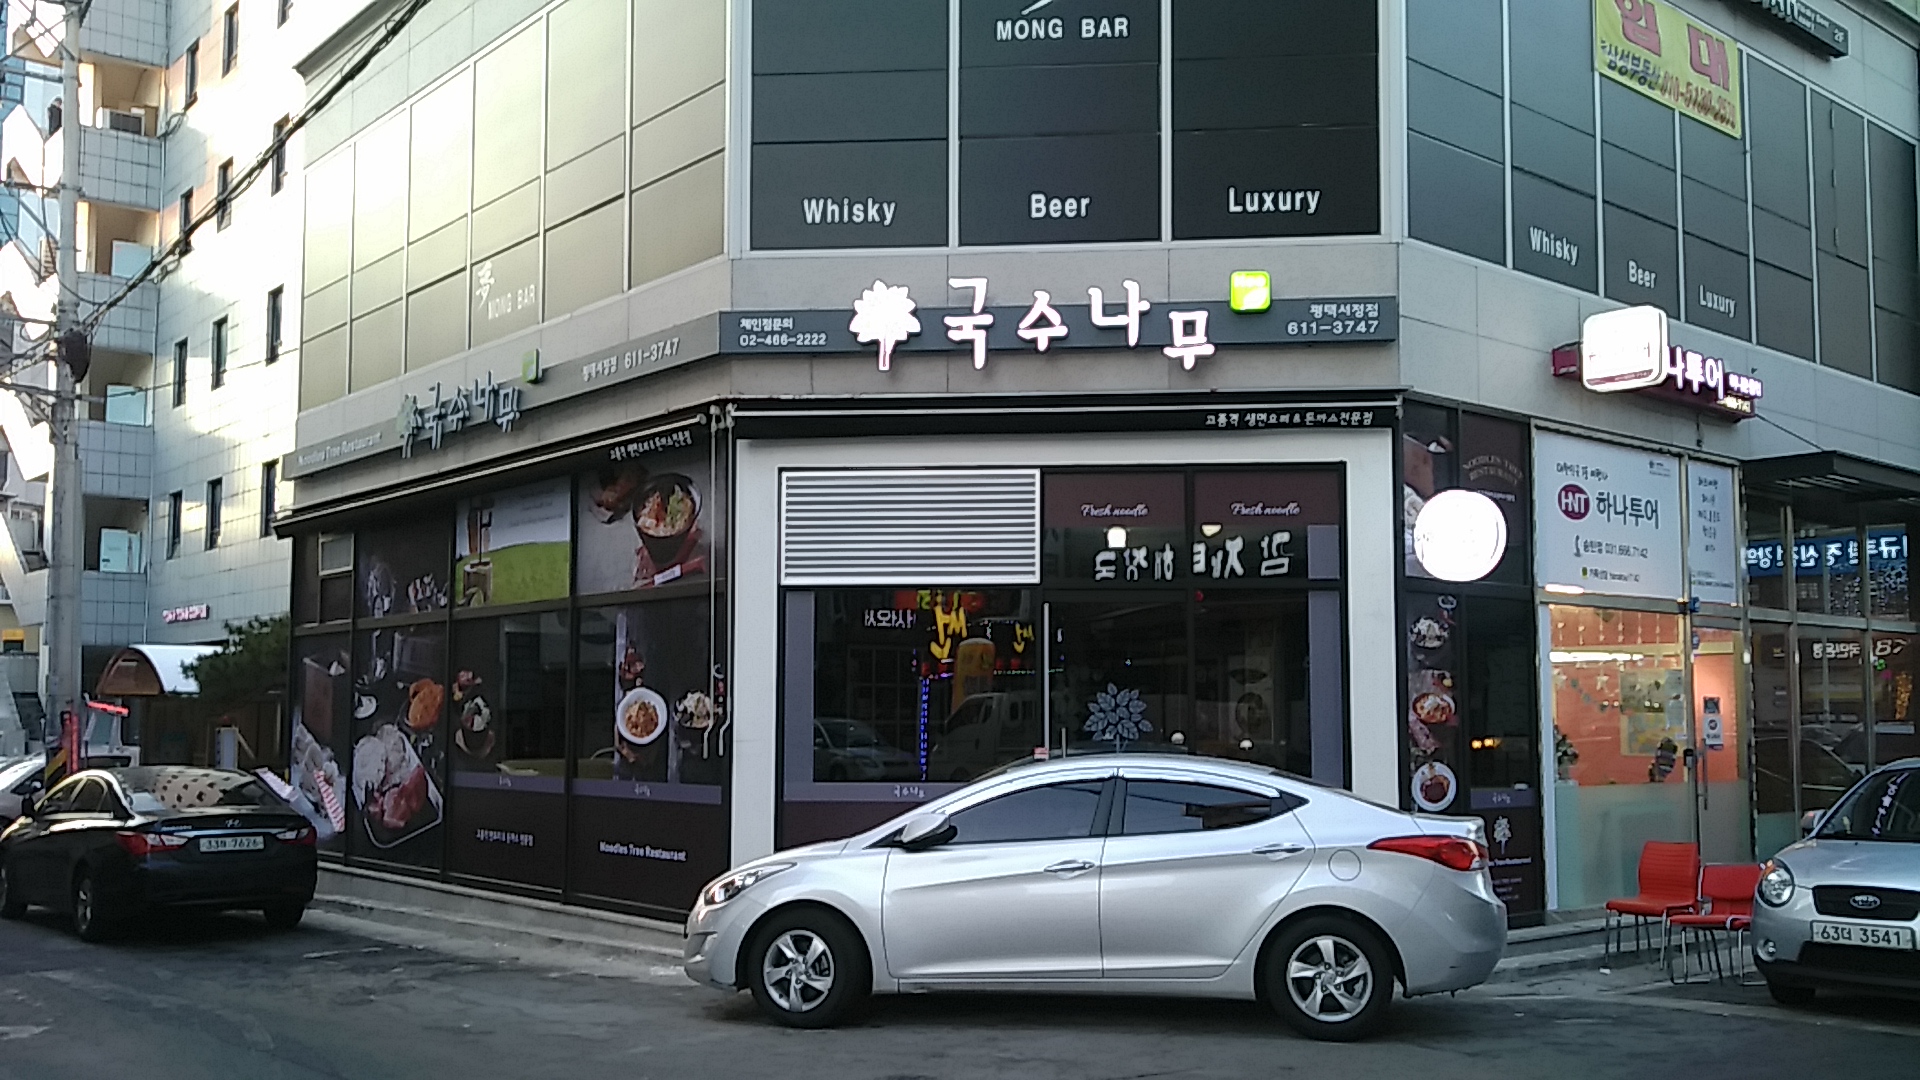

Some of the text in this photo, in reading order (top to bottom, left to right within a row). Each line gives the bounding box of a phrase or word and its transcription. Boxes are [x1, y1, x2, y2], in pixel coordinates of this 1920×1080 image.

[996, 17, 1129, 41] MONG BAR
[803, 198, 896, 226] Whisky
[1030, 193, 1091, 219] Beer
[1228, 187, 1321, 215] Luxury
[1530, 226, 1579, 266] Whisky
[1628, 259, 1656, 289] Beer
[517, 284, 536, 310] BAR
[1699, 284, 1737, 318] Luxury
[943, 277, 1216, 370] 국수나무
[1287, 320, 1380, 335] 611-3747
[624, 337, 680, 370] 611-3747
[1081, 504, 1111, 517] Fresh
[1231, 502, 1261, 516] Fresh
[1596, 491, 1660, 530] 하나투어
[599, 840, 687, 861] Noodles Tree Restaurant
[1859, 927, 1901, 946] 3541
